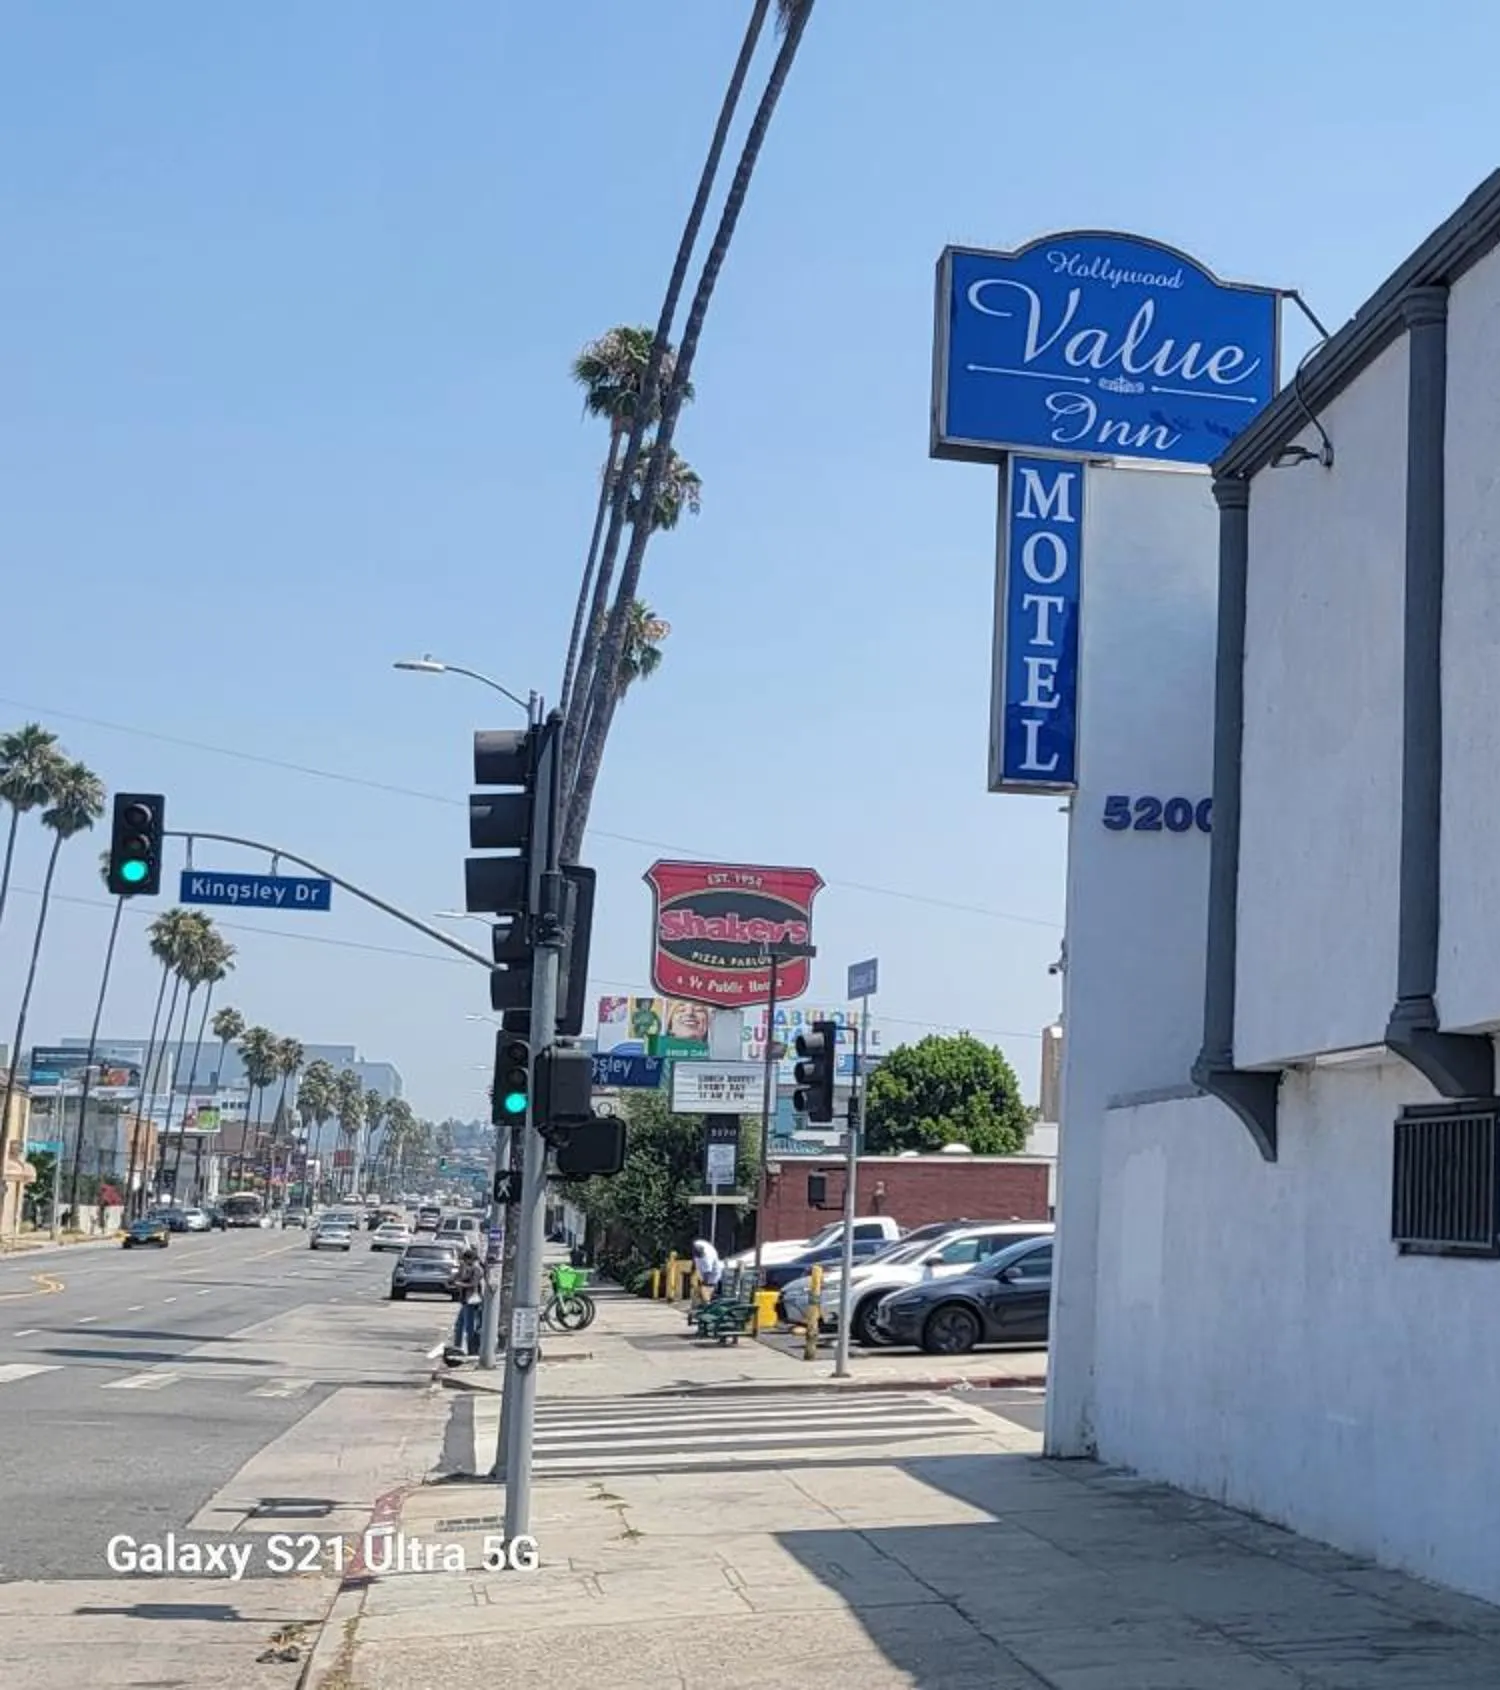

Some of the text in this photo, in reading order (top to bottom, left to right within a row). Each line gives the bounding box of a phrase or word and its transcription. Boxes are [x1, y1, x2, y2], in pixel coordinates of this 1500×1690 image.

[1047, 251, 1184, 289] Hollywood
[967, 278, 1261, 385] Value
[1044, 391, 1182, 451] Inn
[1016, 468, 1075, 772] MOTEL
[191, 878, 321, 904] Kingsley Dr
[691, 951, 725, 966] PIZZA
